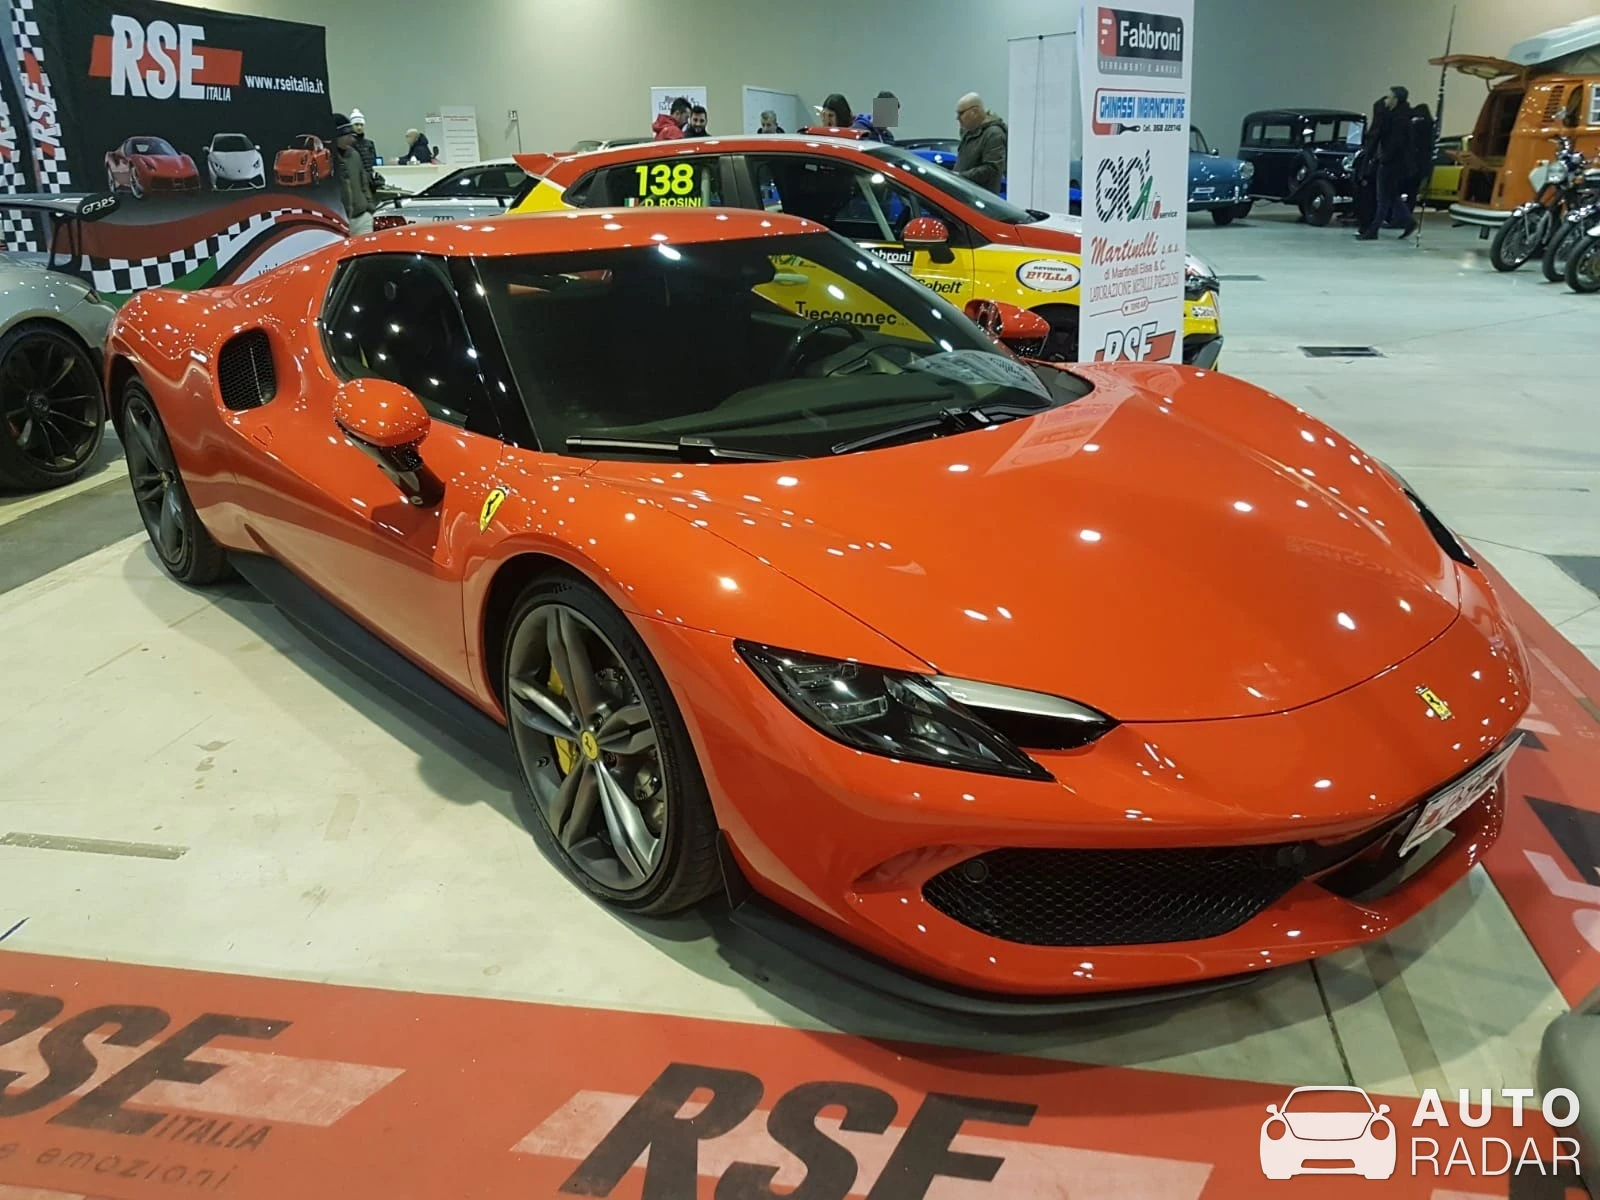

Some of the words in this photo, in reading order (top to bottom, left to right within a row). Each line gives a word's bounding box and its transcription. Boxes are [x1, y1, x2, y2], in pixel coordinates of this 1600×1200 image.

[1119, 20, 1181, 52] Fabbroni
[111, 14, 206, 100] RSE
[205, 86, 231, 101] ITALIA
[245, 74, 325, 95] www.rseitalia.it
[24, 81, 62, 147] RSE
[635, 163, 694, 196] 138
[660, 197, 702, 208] ROSINI
[1090, 232, 1159, 266] Martinelli
[1025, 271, 1073, 282] BULLA
[153, 1113, 273, 1150] ITALIA
[36, 1144, 240, 1191] emozioni
